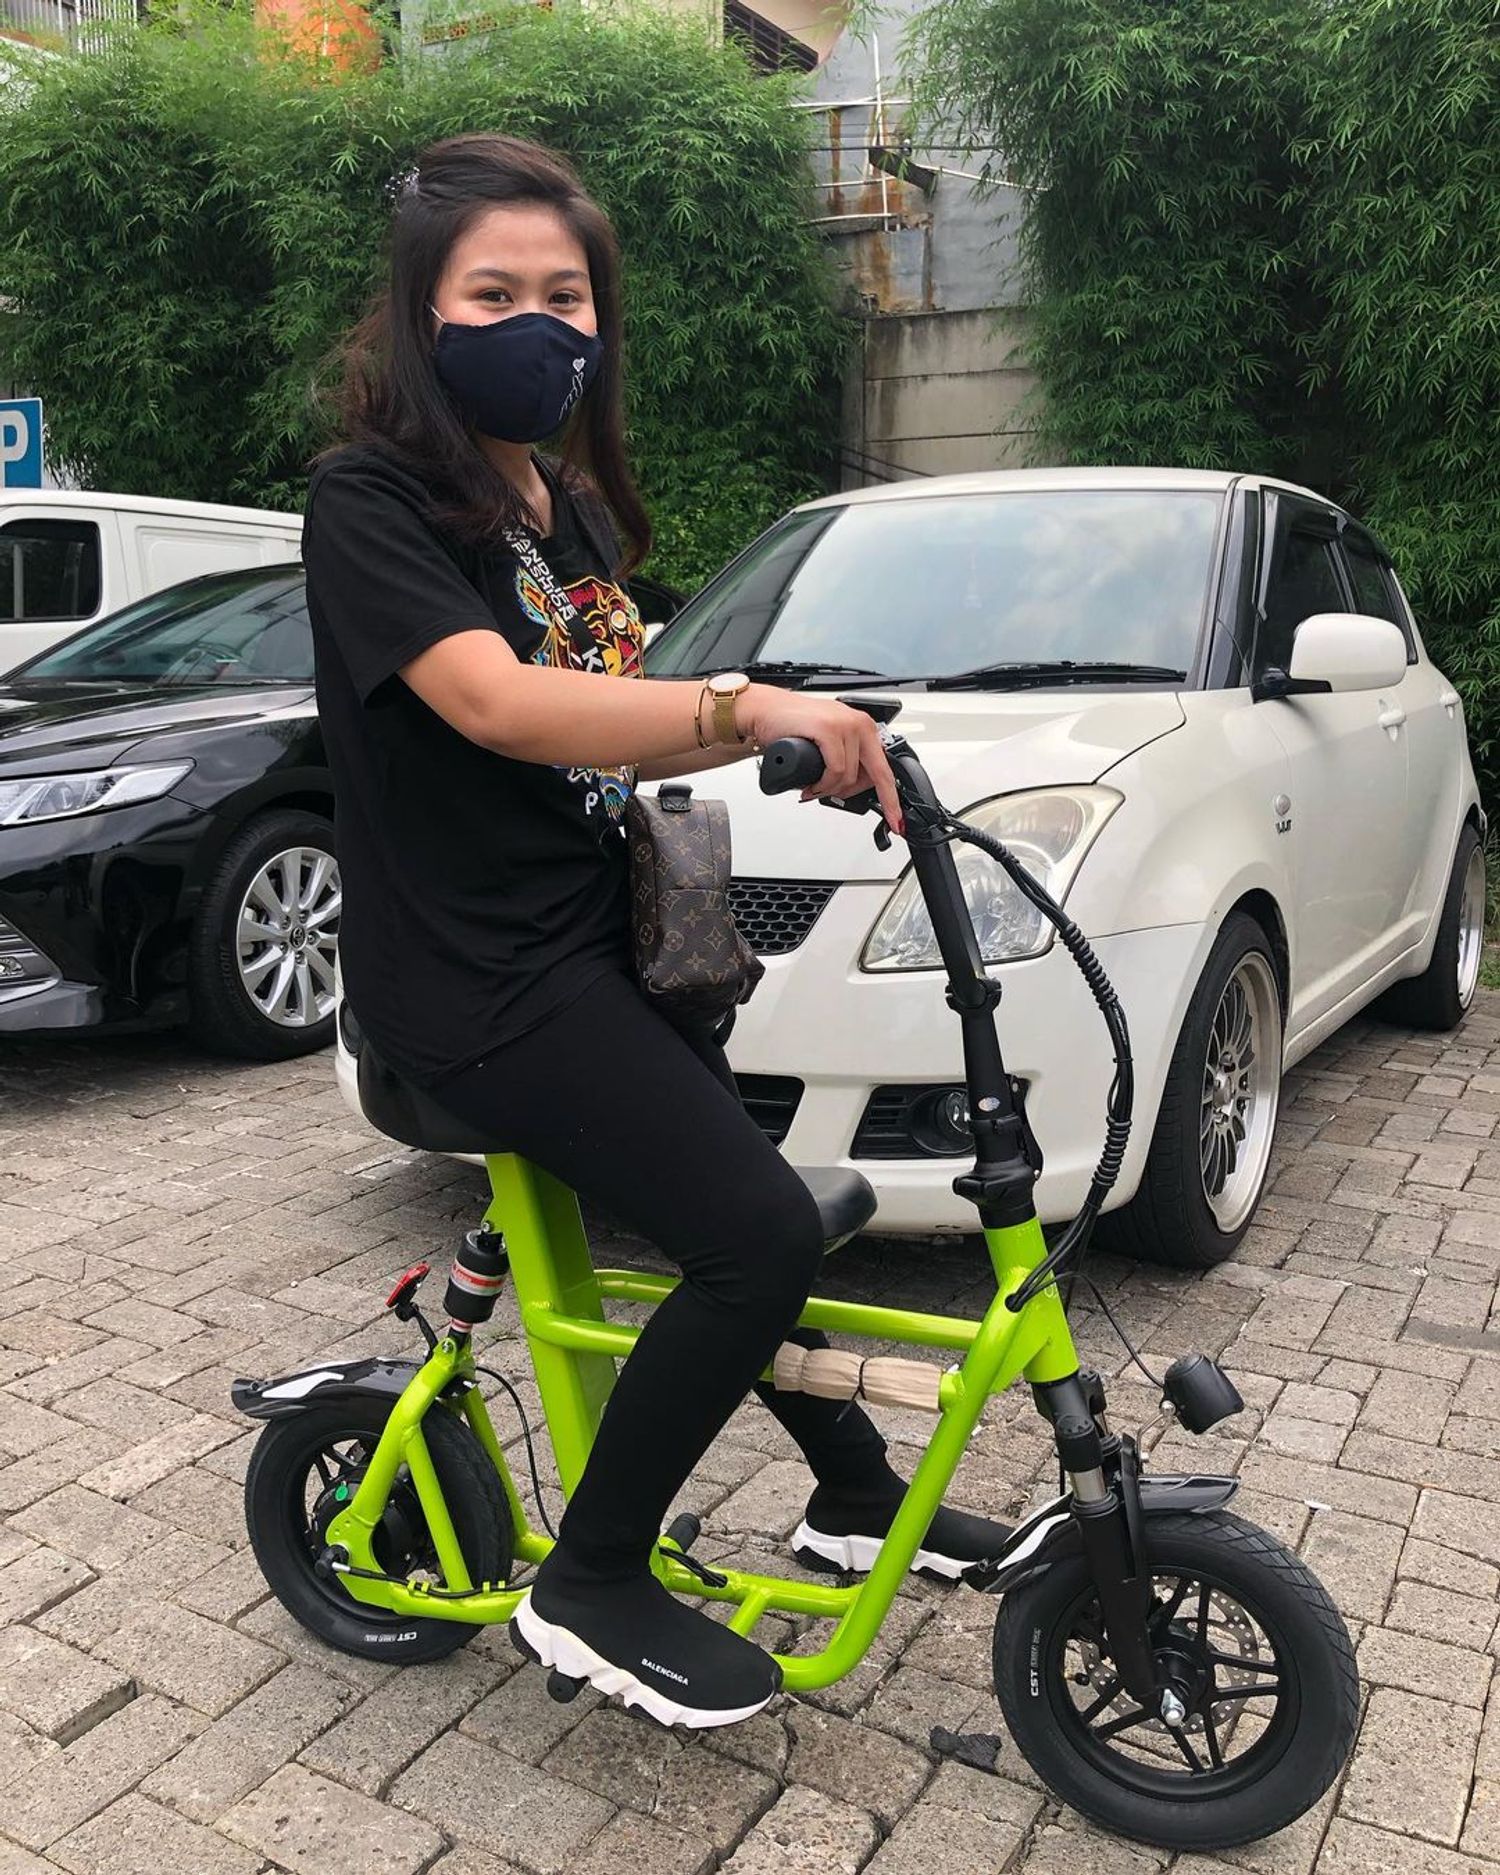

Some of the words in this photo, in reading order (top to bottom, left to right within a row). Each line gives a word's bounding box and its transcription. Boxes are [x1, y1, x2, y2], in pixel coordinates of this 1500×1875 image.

[0, 410, 28, 488] P
[641, 1658, 689, 1686] BALENCIAGA
[1030, 1669, 1039, 1697] CST
